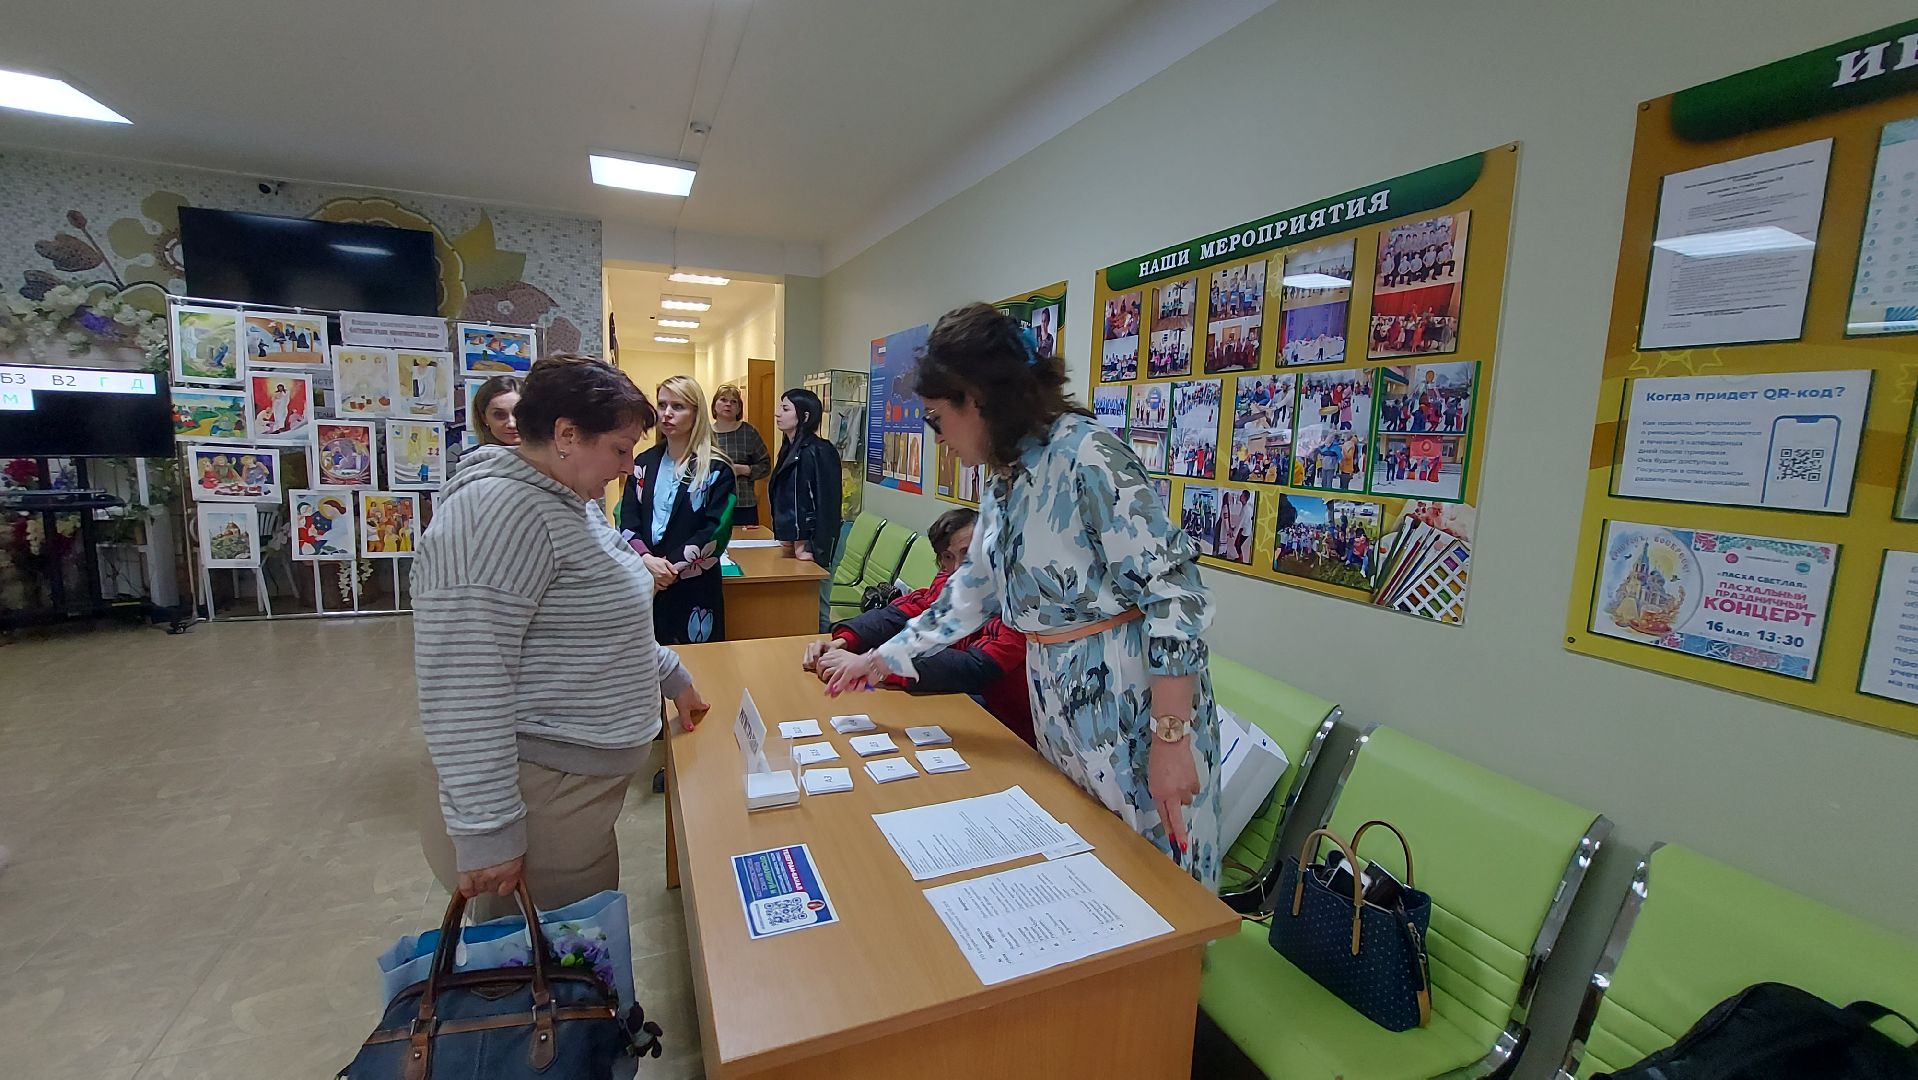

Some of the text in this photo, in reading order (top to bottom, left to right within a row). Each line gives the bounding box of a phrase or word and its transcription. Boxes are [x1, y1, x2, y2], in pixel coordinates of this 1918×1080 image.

[1138, 189, 1391, 278] НАШИ МЕРОПРИЯТИЯ
[0, 372, 26, 384] Б3
[52, 374, 77, 386] В2
[131, 378, 144, 390] Д
[3, 394, 18, 404] М
[1646, 386, 1846, 402] Когда придет QR-код?
[1654, 457, 1676, 465] будет
[1715, 589, 1809, 611] ПРАЗДНИЧНЫЙ
[1719, 581, 1807, 601] ПАСХАЛЬНЫЙ
[1703, 596, 1817, 627] КОНЦЕРТ
[1706, 620, 1805, 648] 16 МАЯ 13:30
[823, 775, 833, 783] А3
